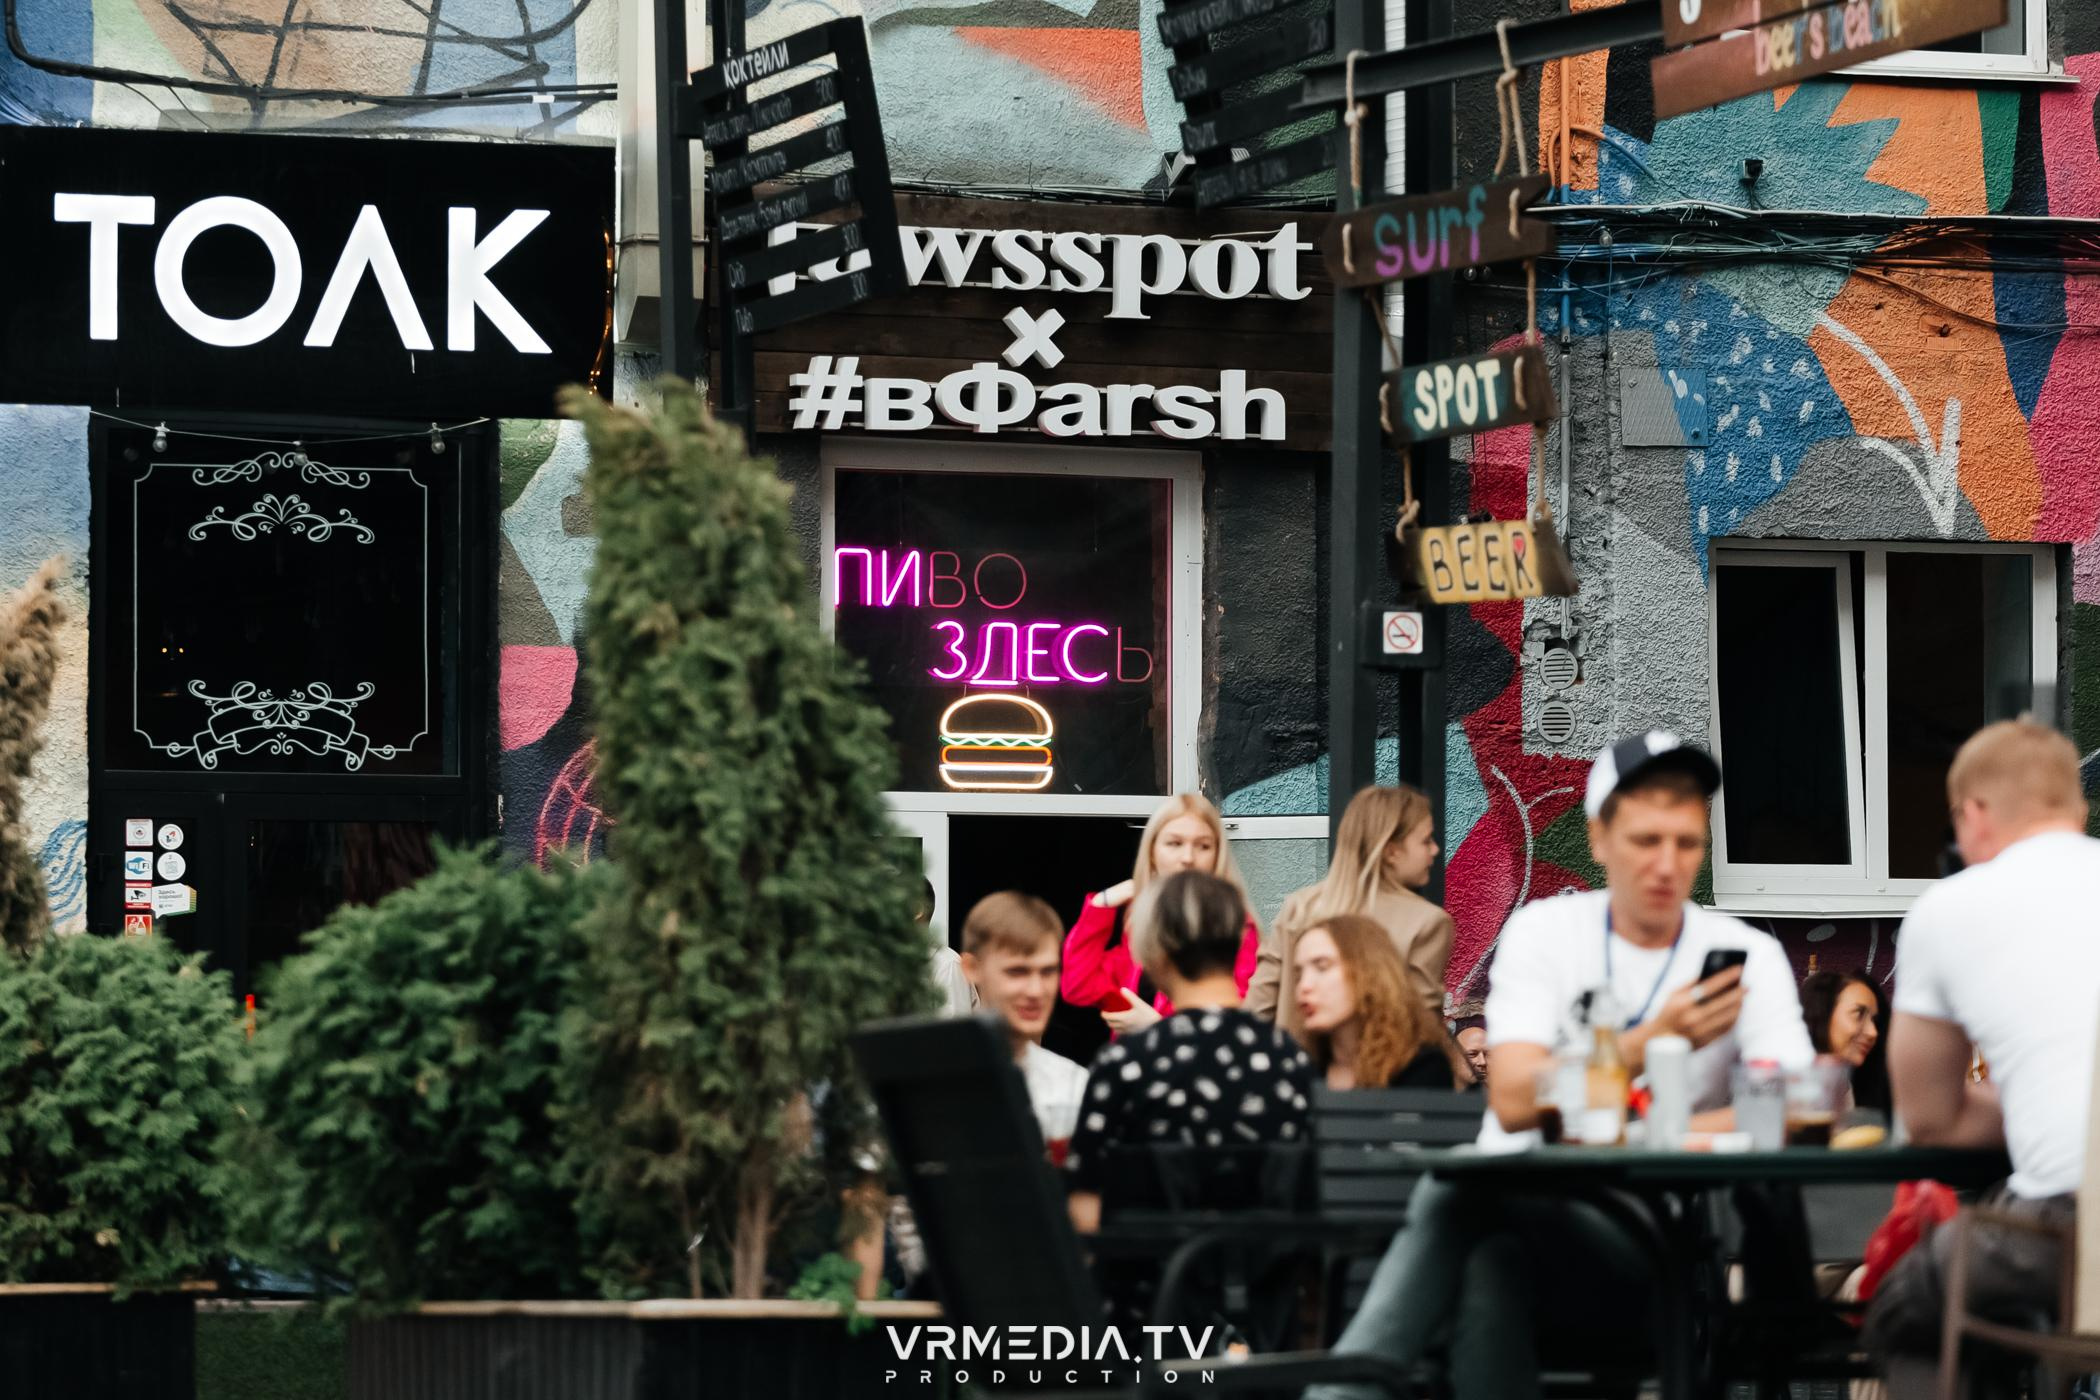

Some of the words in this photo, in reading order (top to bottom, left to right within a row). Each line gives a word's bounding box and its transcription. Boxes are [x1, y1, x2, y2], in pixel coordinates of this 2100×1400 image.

[768, 221, 1313, 320] wsspot
[1413, 358, 1502, 431] SPOT
[834, 546, 1028, 609] ПИВО
[1428, 529, 1538, 597] BEER
[930, 619, 1154, 687] ЗДЕСЬ
